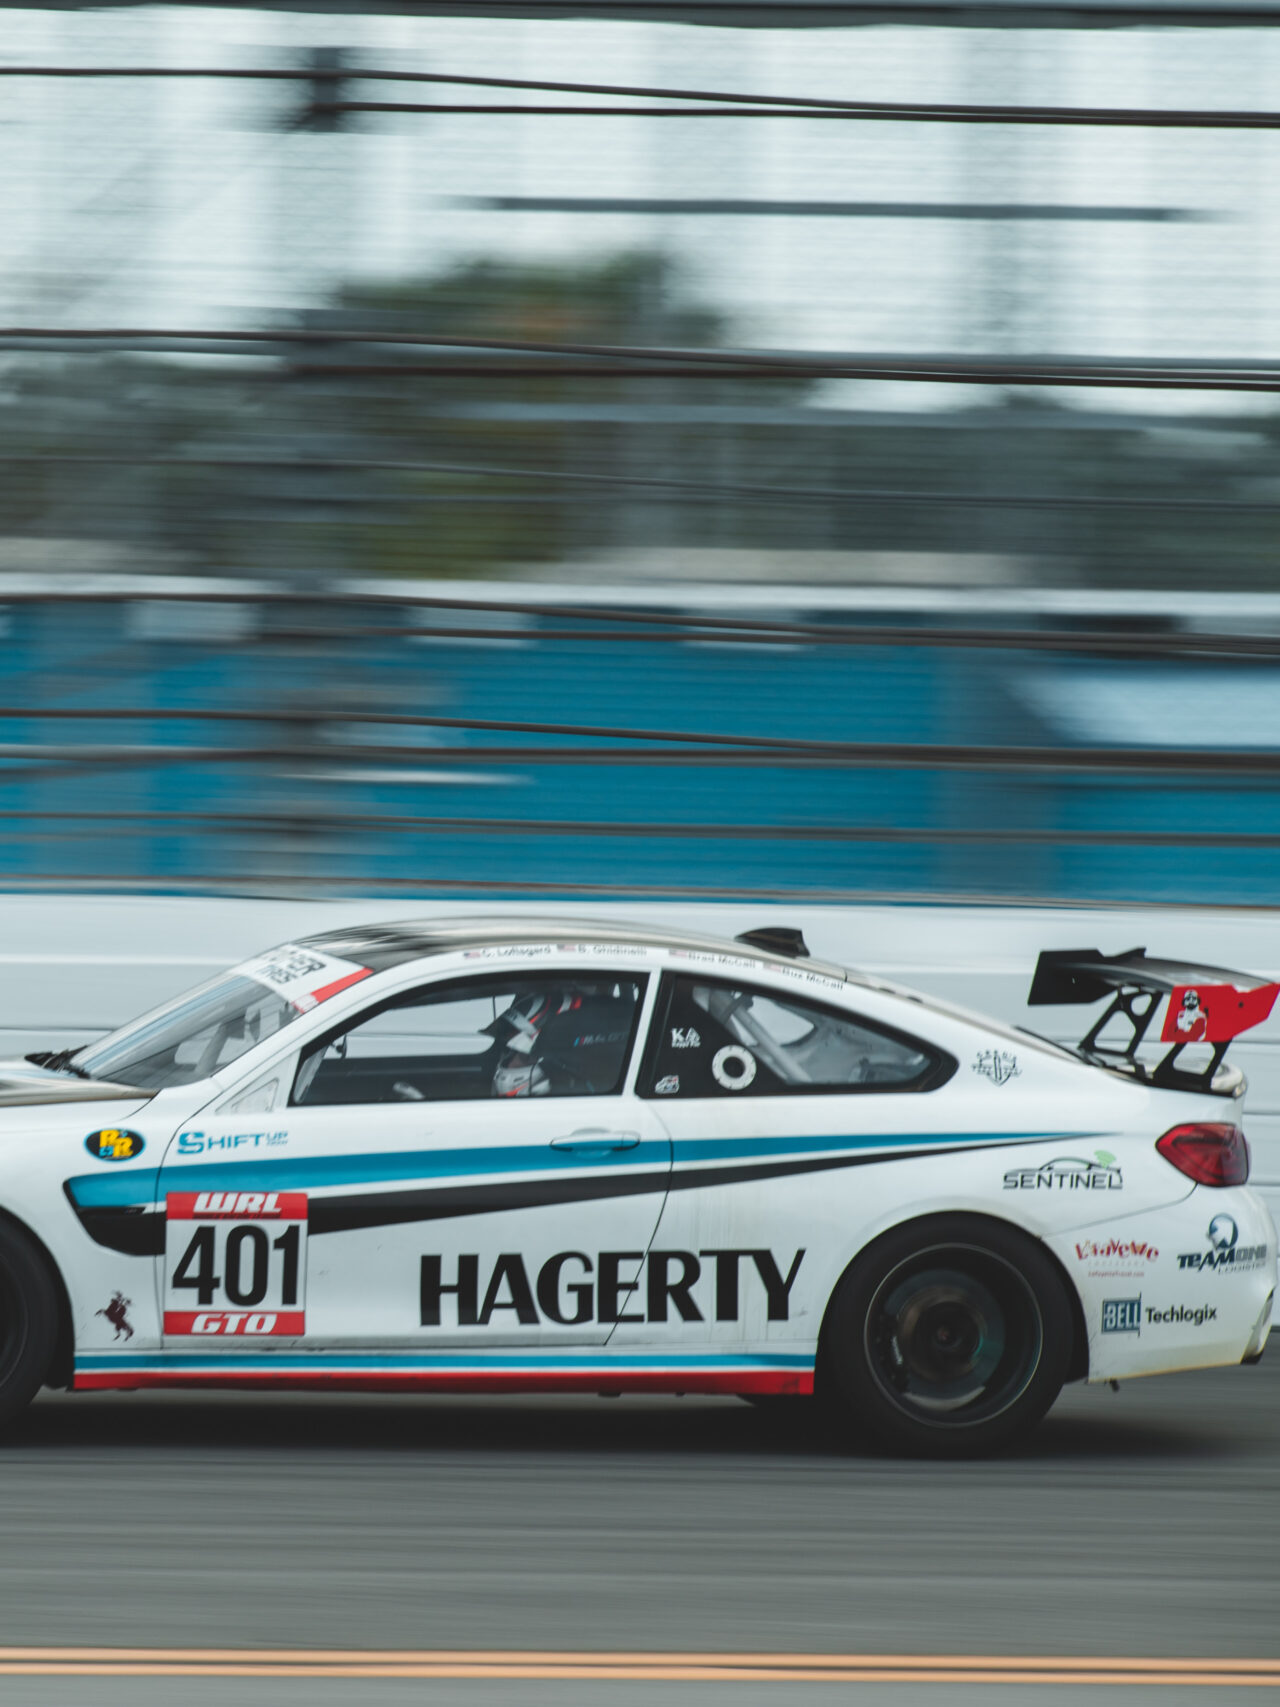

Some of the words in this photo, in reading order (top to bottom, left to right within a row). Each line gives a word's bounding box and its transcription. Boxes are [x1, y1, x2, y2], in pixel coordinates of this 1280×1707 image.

[1003, 1169, 1122, 1190] SENTINEL
[193, 1192, 281, 1213] WRL
[172, 1224, 300, 1307] 401
[420, 1248, 807, 1326] HAGERTY
[191, 1313, 277, 1334] GTO
[1104, 1301, 1140, 1330] BELL
[1145, 1303, 1218, 1326] Techlogix
